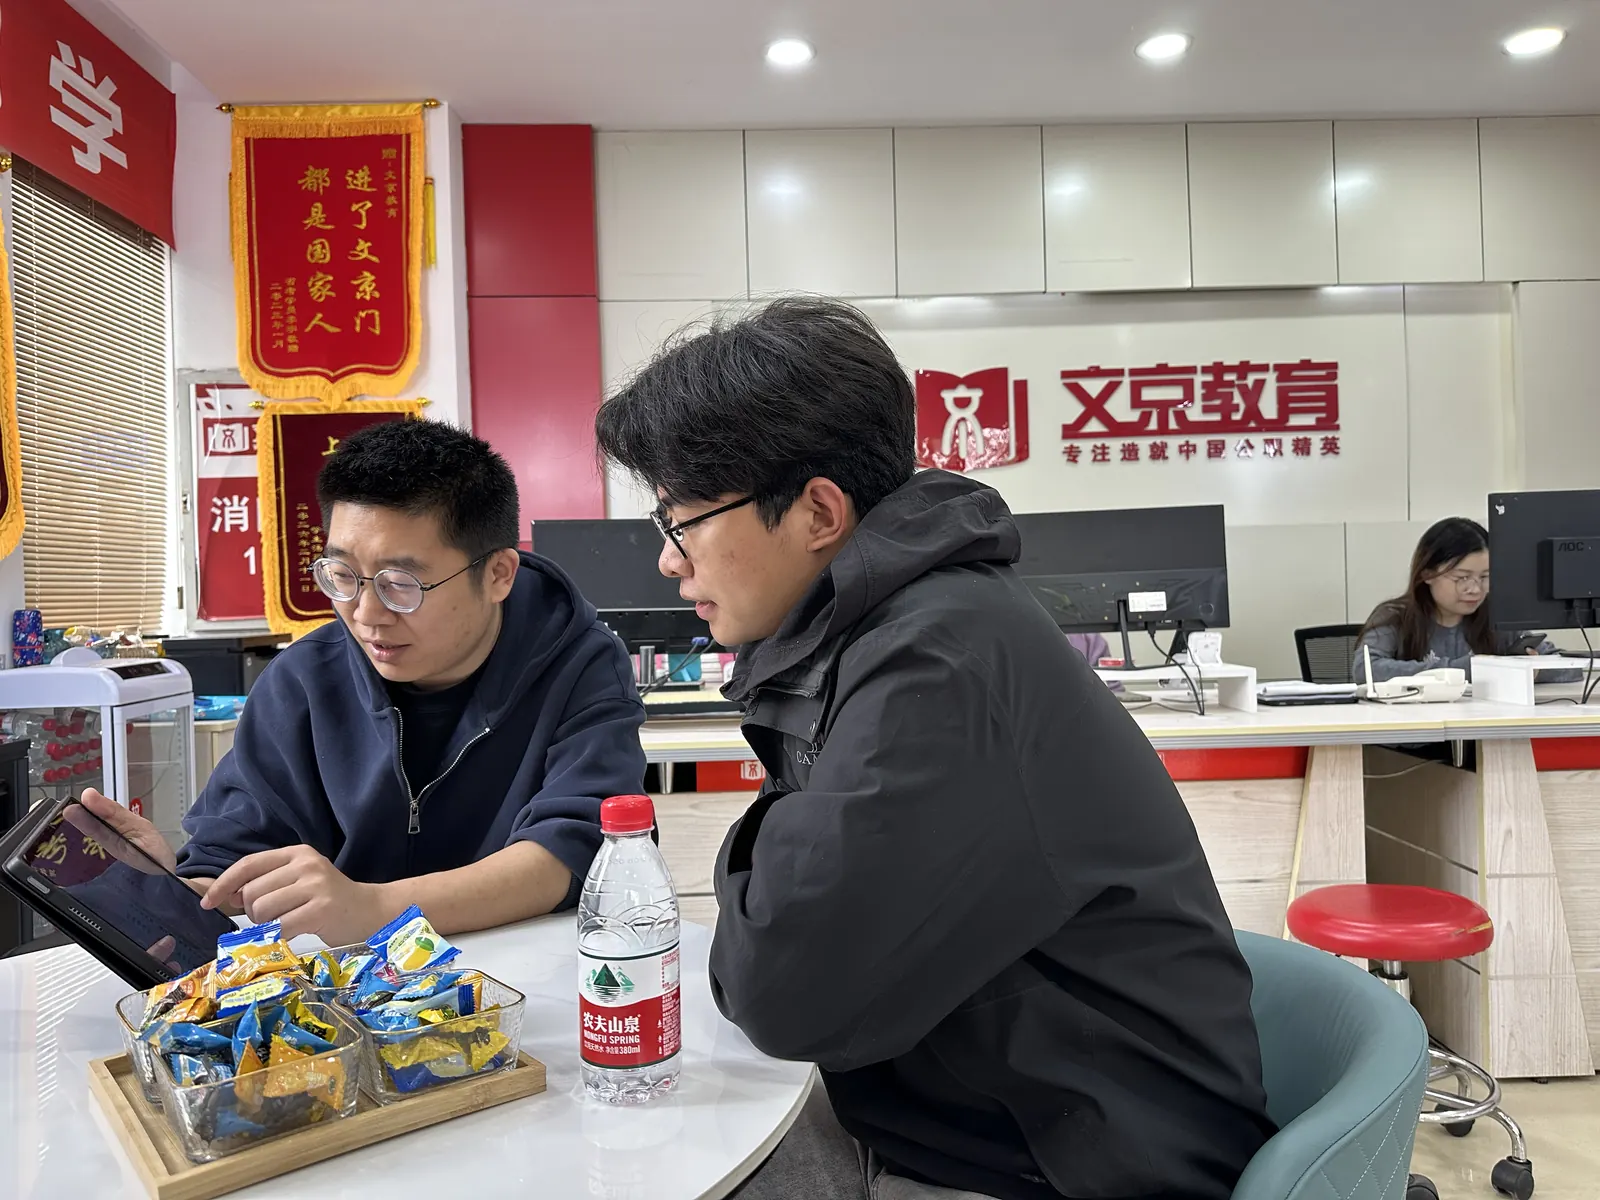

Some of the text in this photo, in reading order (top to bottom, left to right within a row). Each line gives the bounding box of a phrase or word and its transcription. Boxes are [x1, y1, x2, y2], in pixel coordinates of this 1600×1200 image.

[49, 40, 128, 174] 学
[298, 165, 342, 333] 都是国家人
[344, 165, 380, 335] 进了文京门
[1060, 359, 1340, 440] 文京教育
[1062, 436, 1339, 464] 专注造就中国公职精英
[210, 495, 261, 533] 消
[1558, 541, 1585, 552] AOC
[583, 1011, 640, 1033] 农夫山泉
[584, 1029, 640, 1044] NONGFU SPRING
